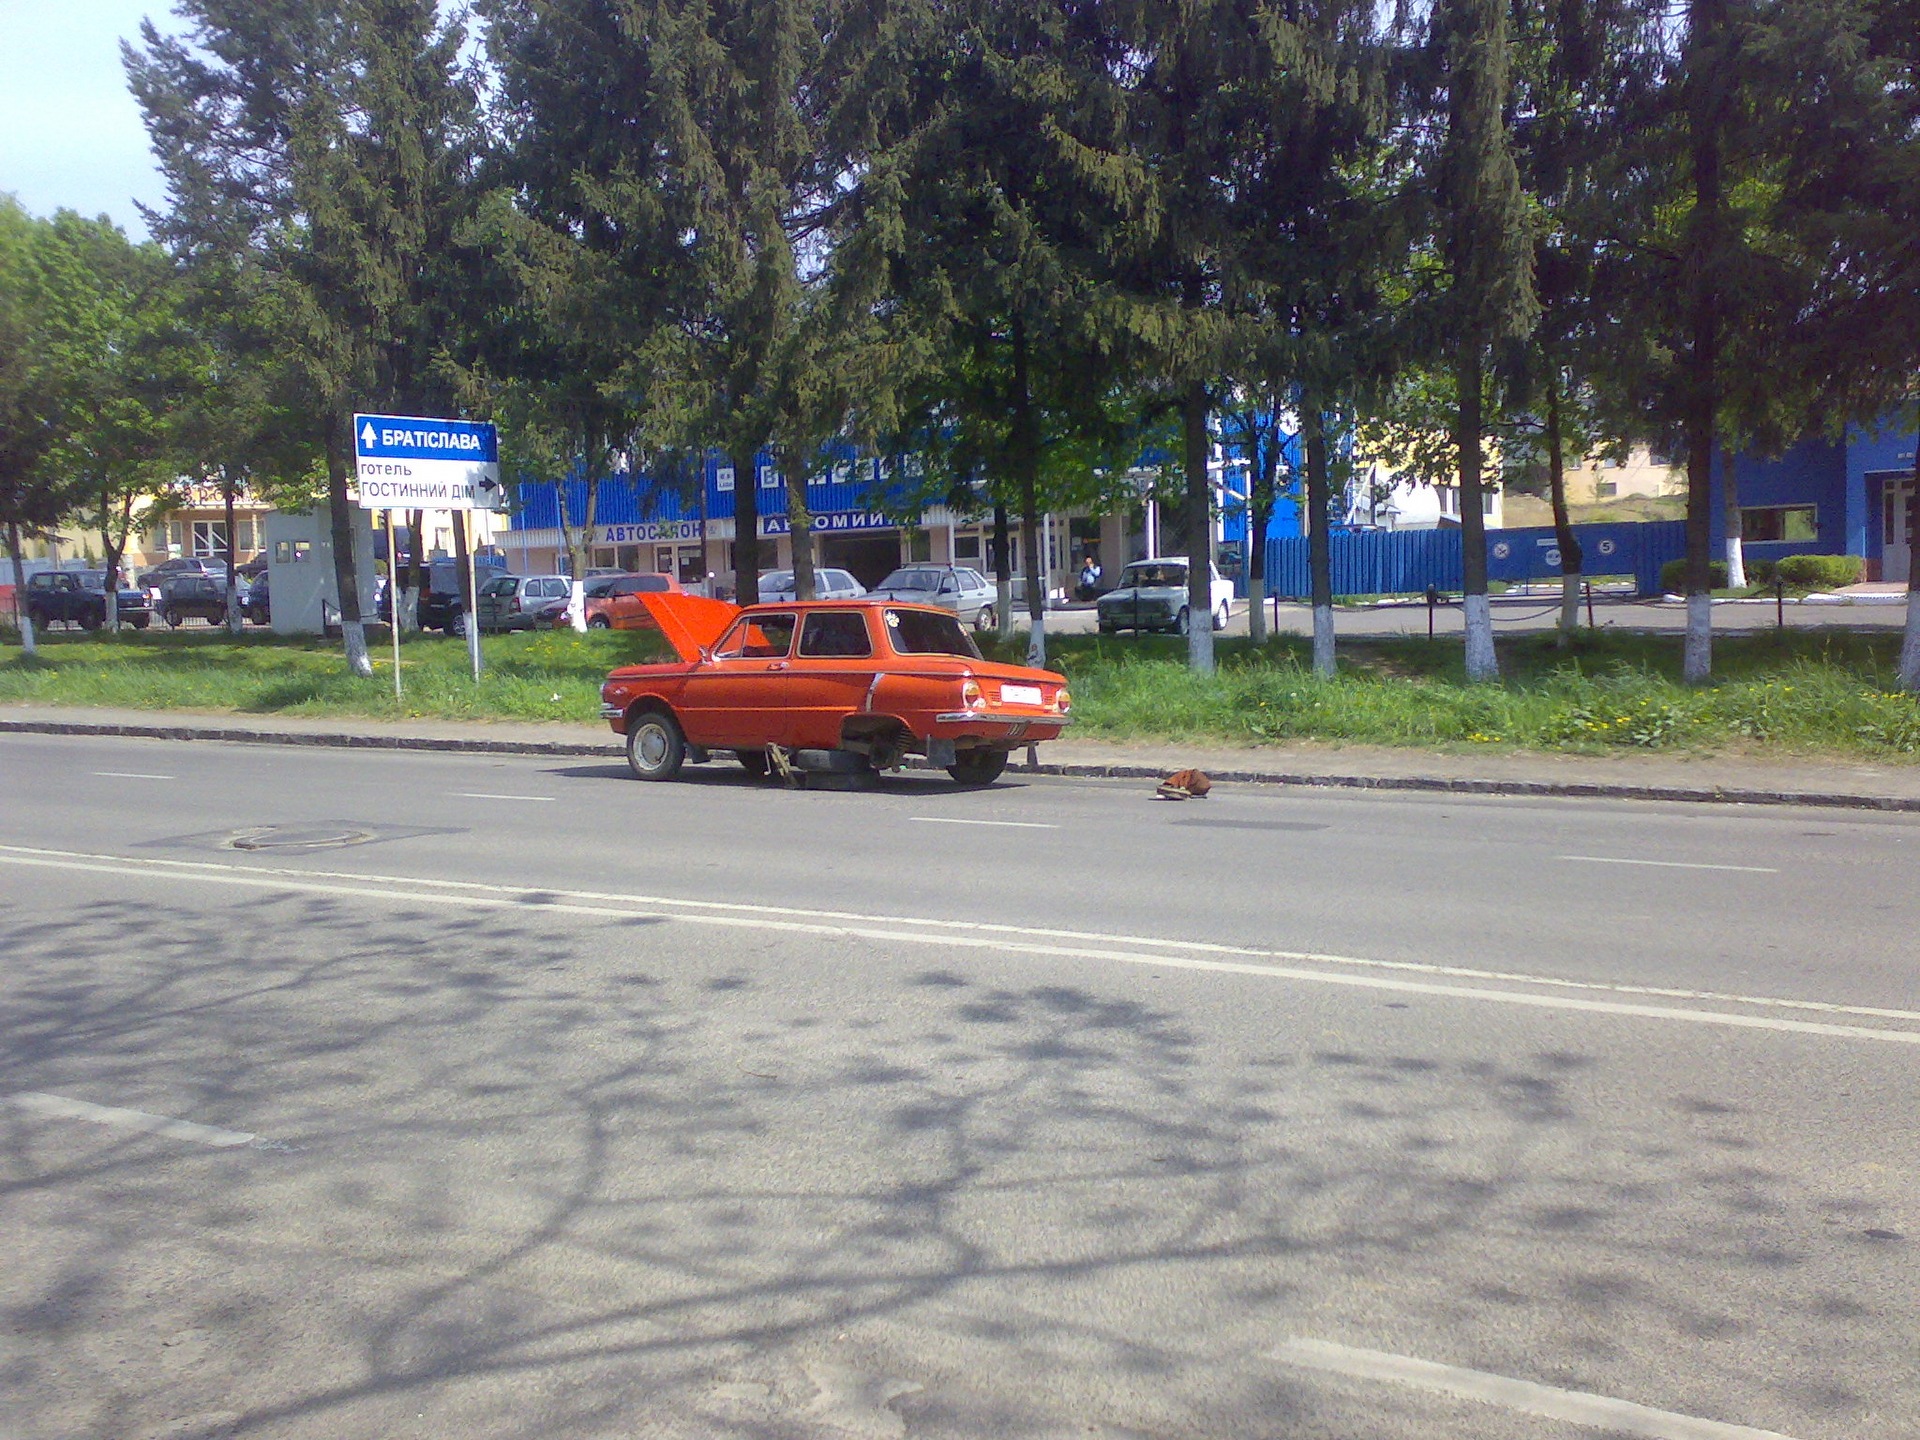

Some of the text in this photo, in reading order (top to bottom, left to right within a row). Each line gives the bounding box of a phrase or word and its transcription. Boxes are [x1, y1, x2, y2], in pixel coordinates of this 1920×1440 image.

[382, 429, 481, 450] БРАТІСЛАВА
[361, 463, 412, 476] готель
[362, 481, 475, 500] ГОСТИННИЙ ДІМ
